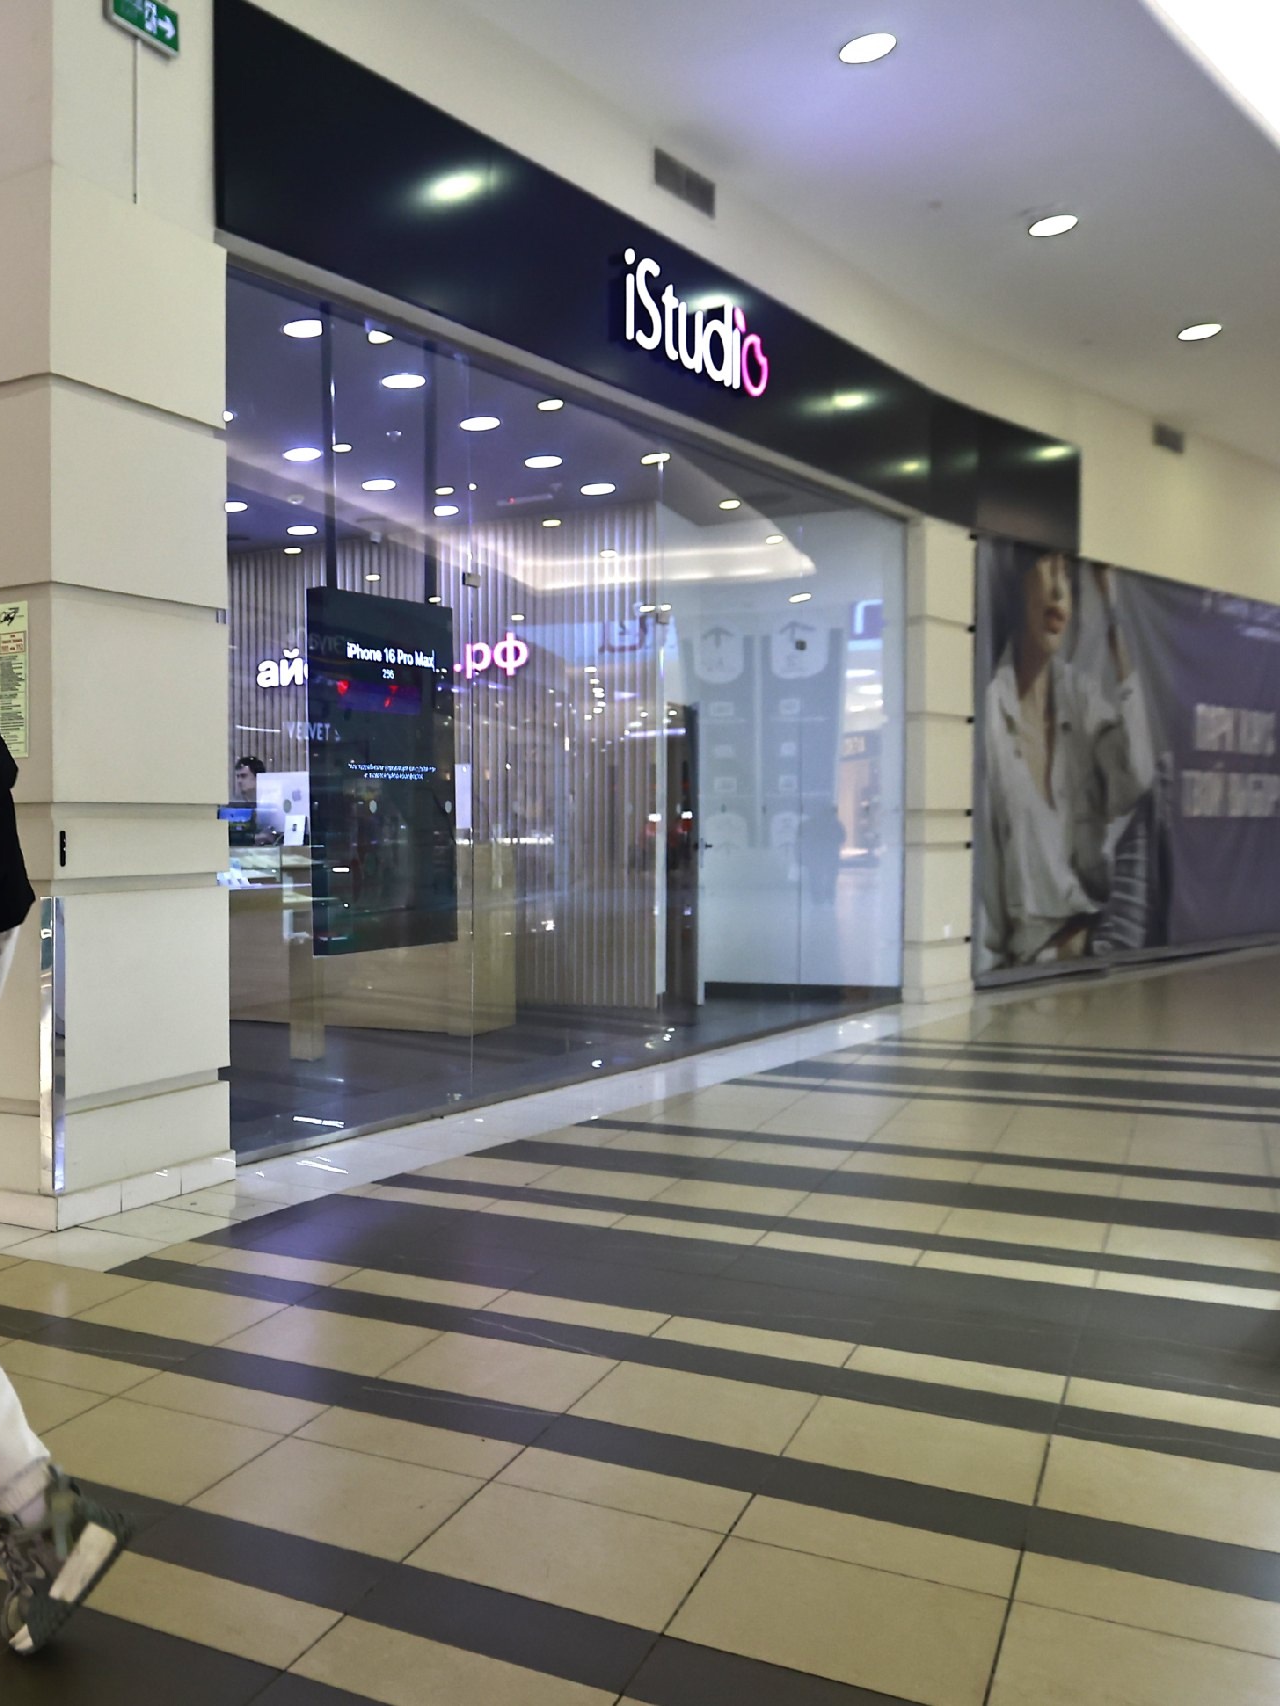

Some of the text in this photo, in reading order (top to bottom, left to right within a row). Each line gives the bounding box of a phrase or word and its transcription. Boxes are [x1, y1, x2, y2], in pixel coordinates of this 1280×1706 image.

[624, 247, 769, 397] iStudio
[256, 647, 308, 688] ай
[346, 641, 382, 663] iPhone
[384, 647, 396, 664] 16
[397, 649, 414, 666] Pro
[415, 650, 435, 669] Max
